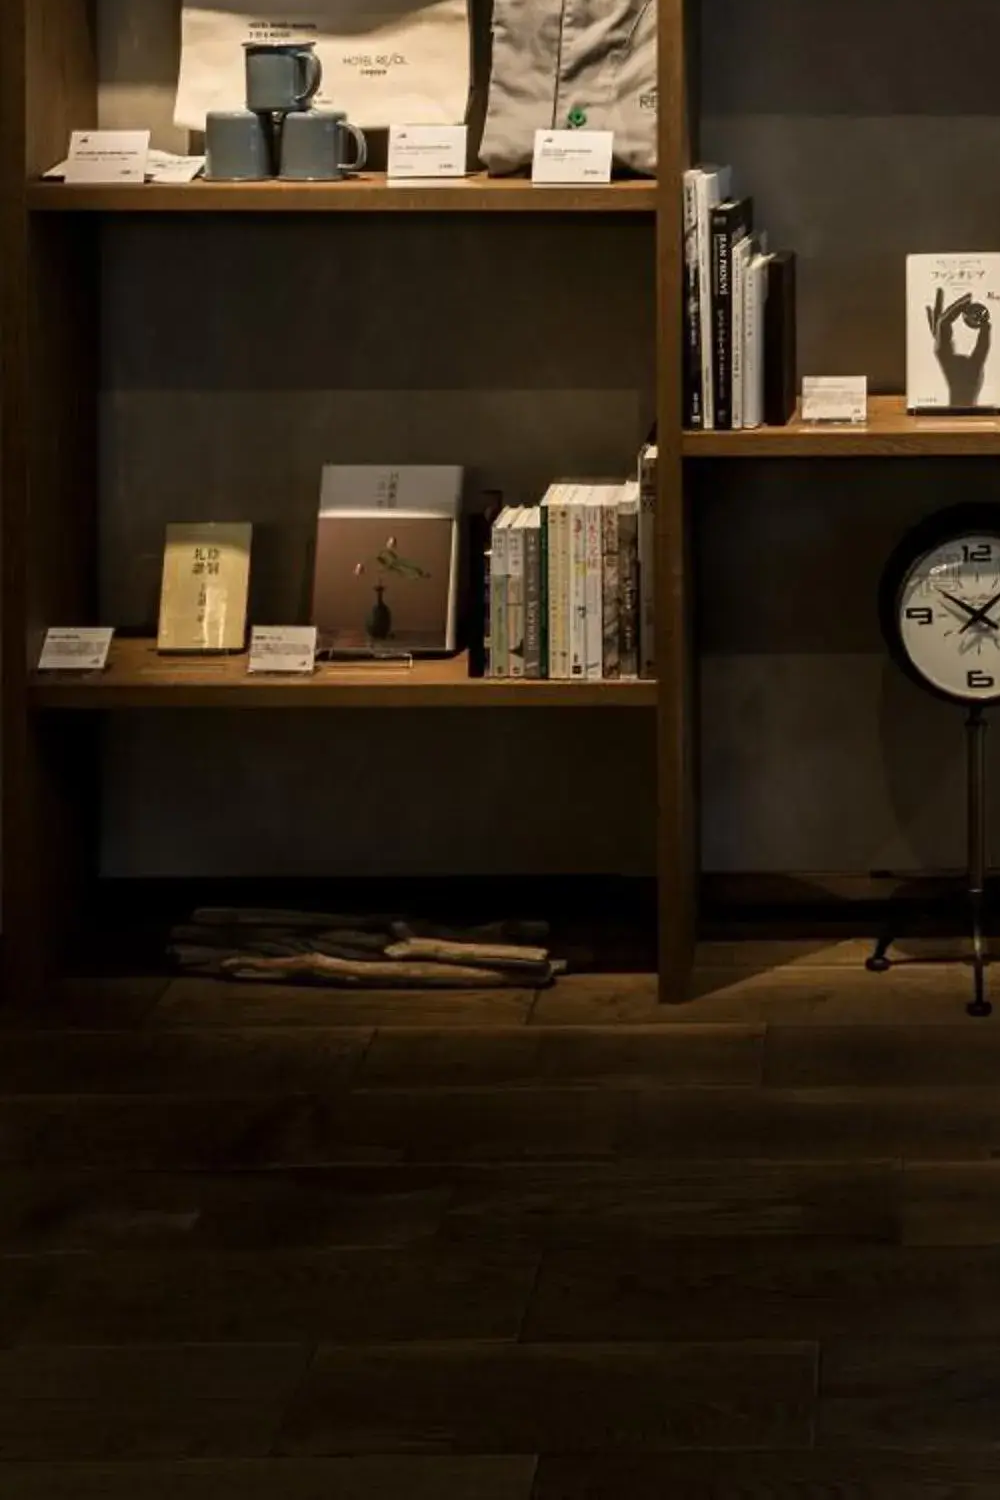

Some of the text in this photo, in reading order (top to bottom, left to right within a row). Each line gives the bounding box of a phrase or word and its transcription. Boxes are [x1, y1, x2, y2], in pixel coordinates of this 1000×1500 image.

[342, 55, 372, 66] HOTEL
[962, 544, 992, 563] 12
[906, 607, 933, 625] 9
[967, 670, 994, 688] 6
